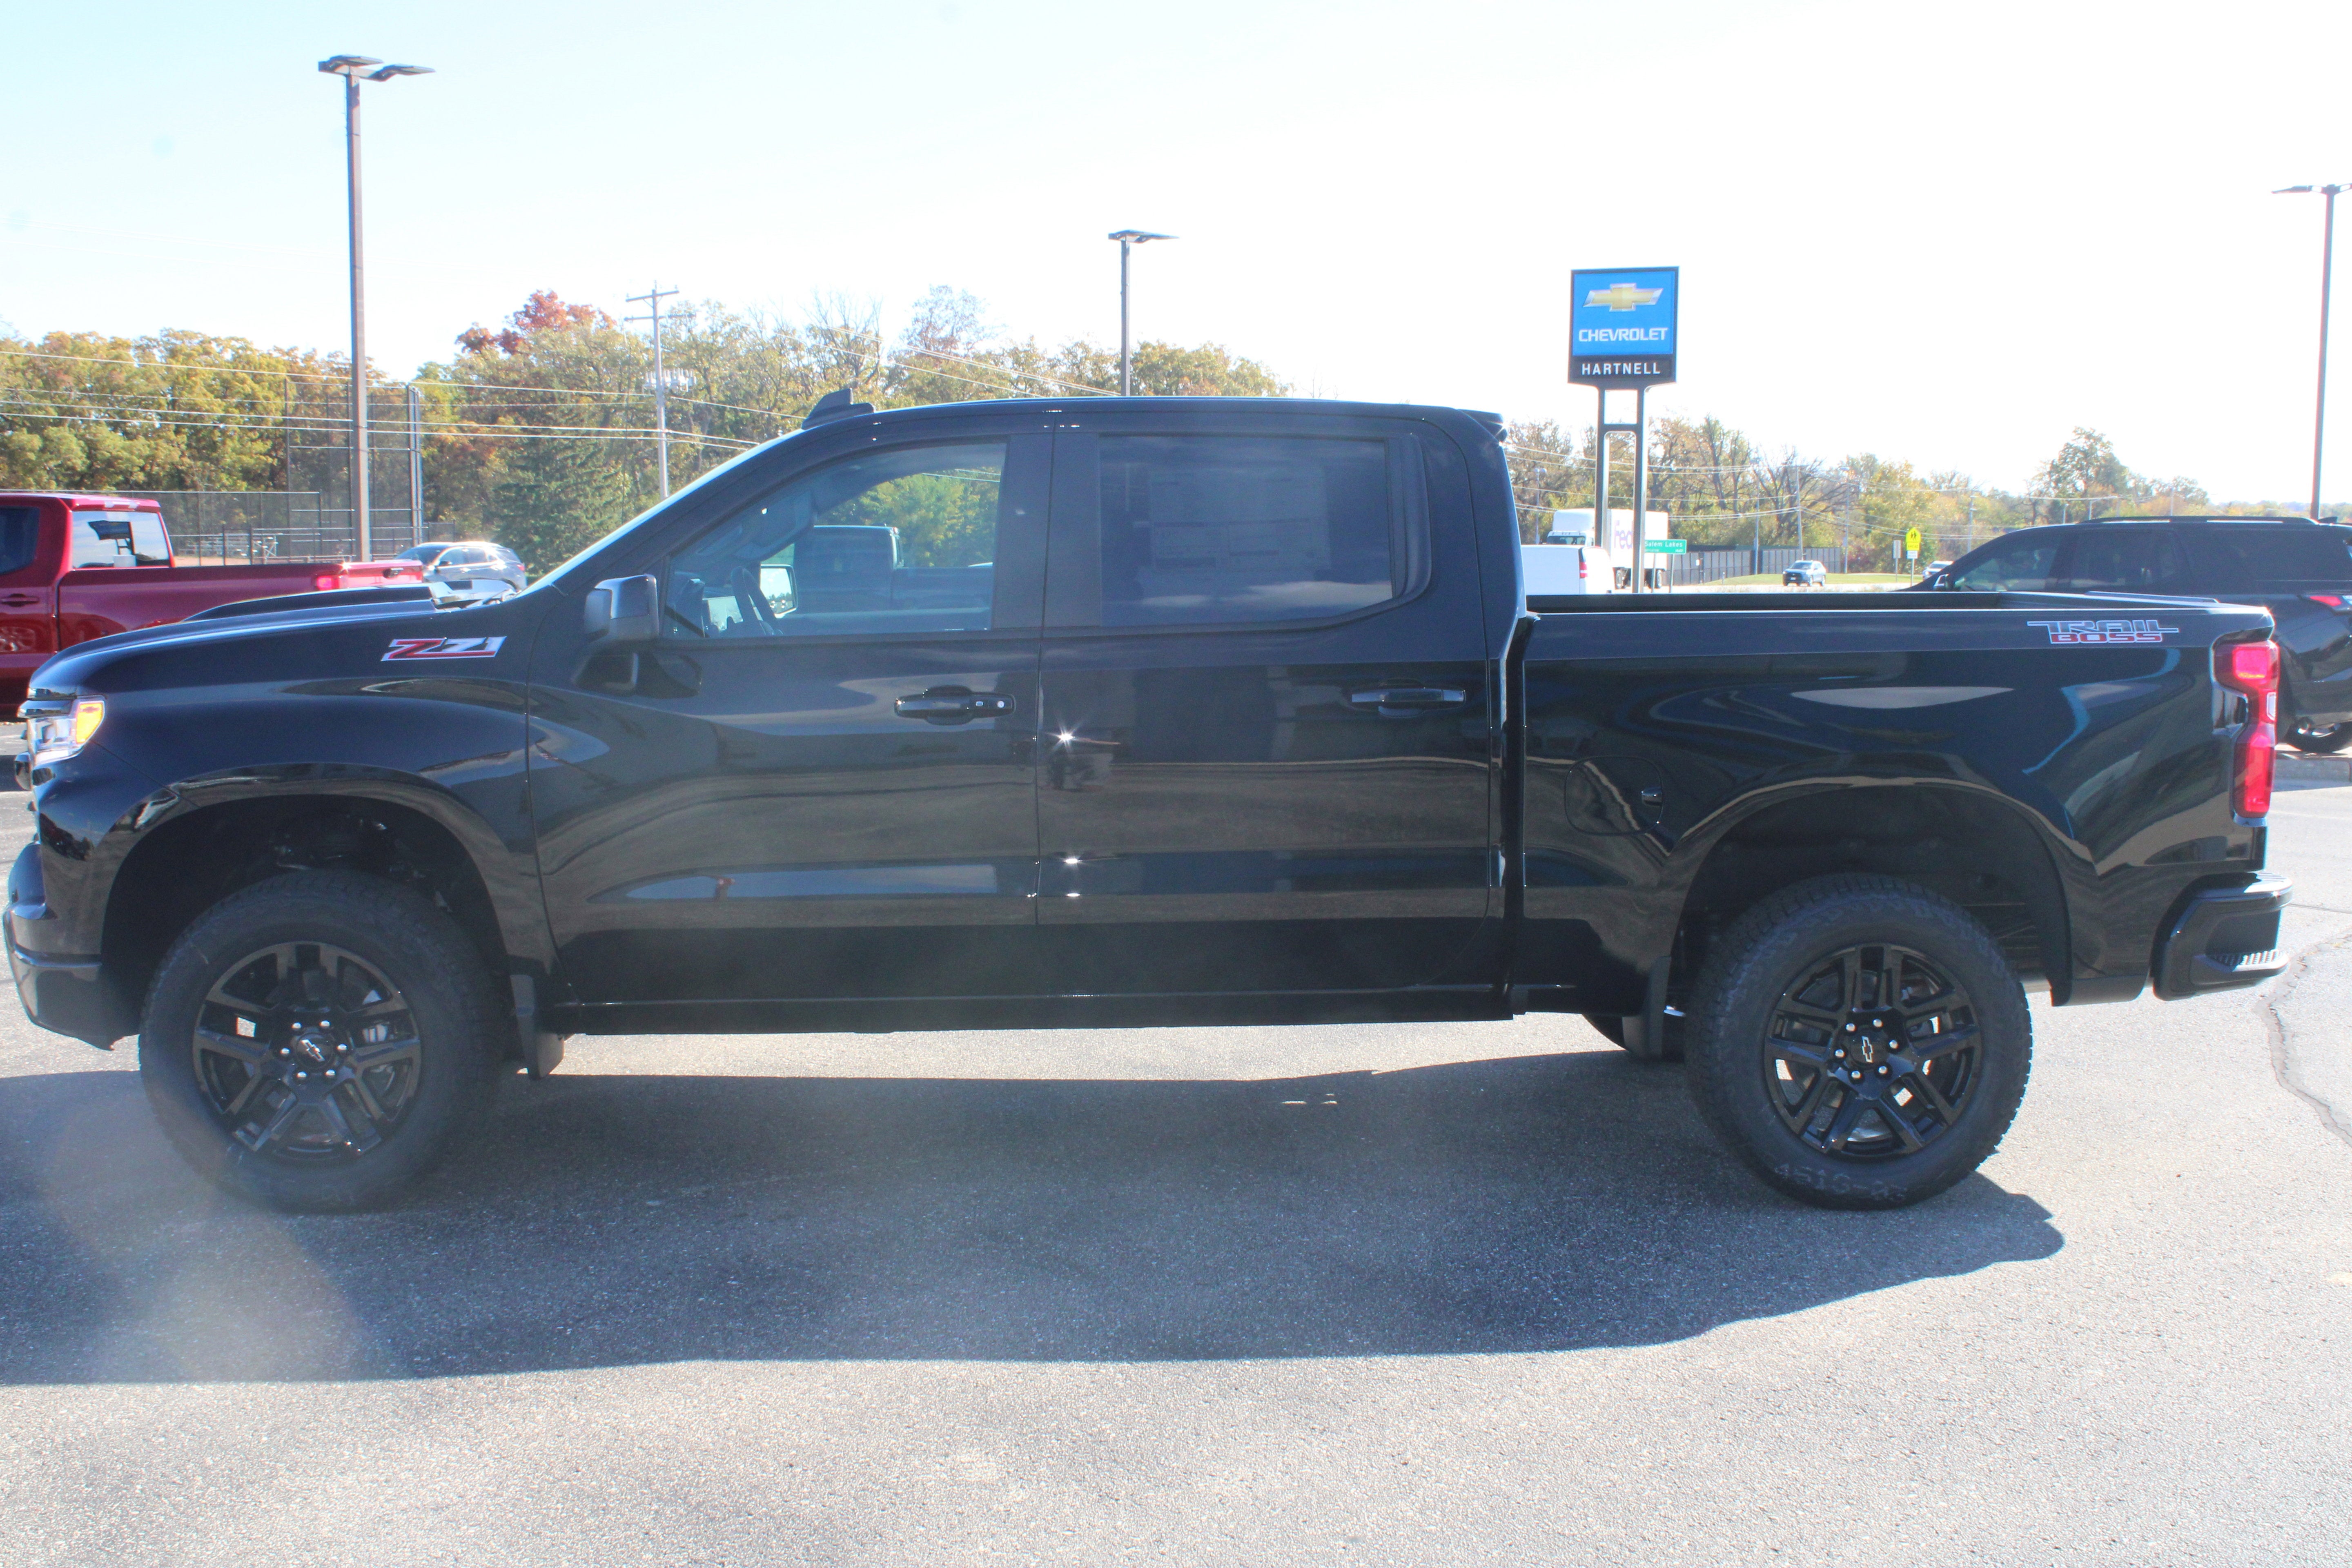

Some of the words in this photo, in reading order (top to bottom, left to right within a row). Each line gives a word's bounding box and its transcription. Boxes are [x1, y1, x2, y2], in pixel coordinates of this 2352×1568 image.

[1579, 327, 1668, 342] CHEVROLET
[1581, 362, 1661, 375] HARTNELL
[1614, 520, 1634, 550] Fed
[2027, 619, 2180, 633] TRAIL
[2050, 632, 2163, 644] BOSS
[380, 635, 508, 662] Z71
